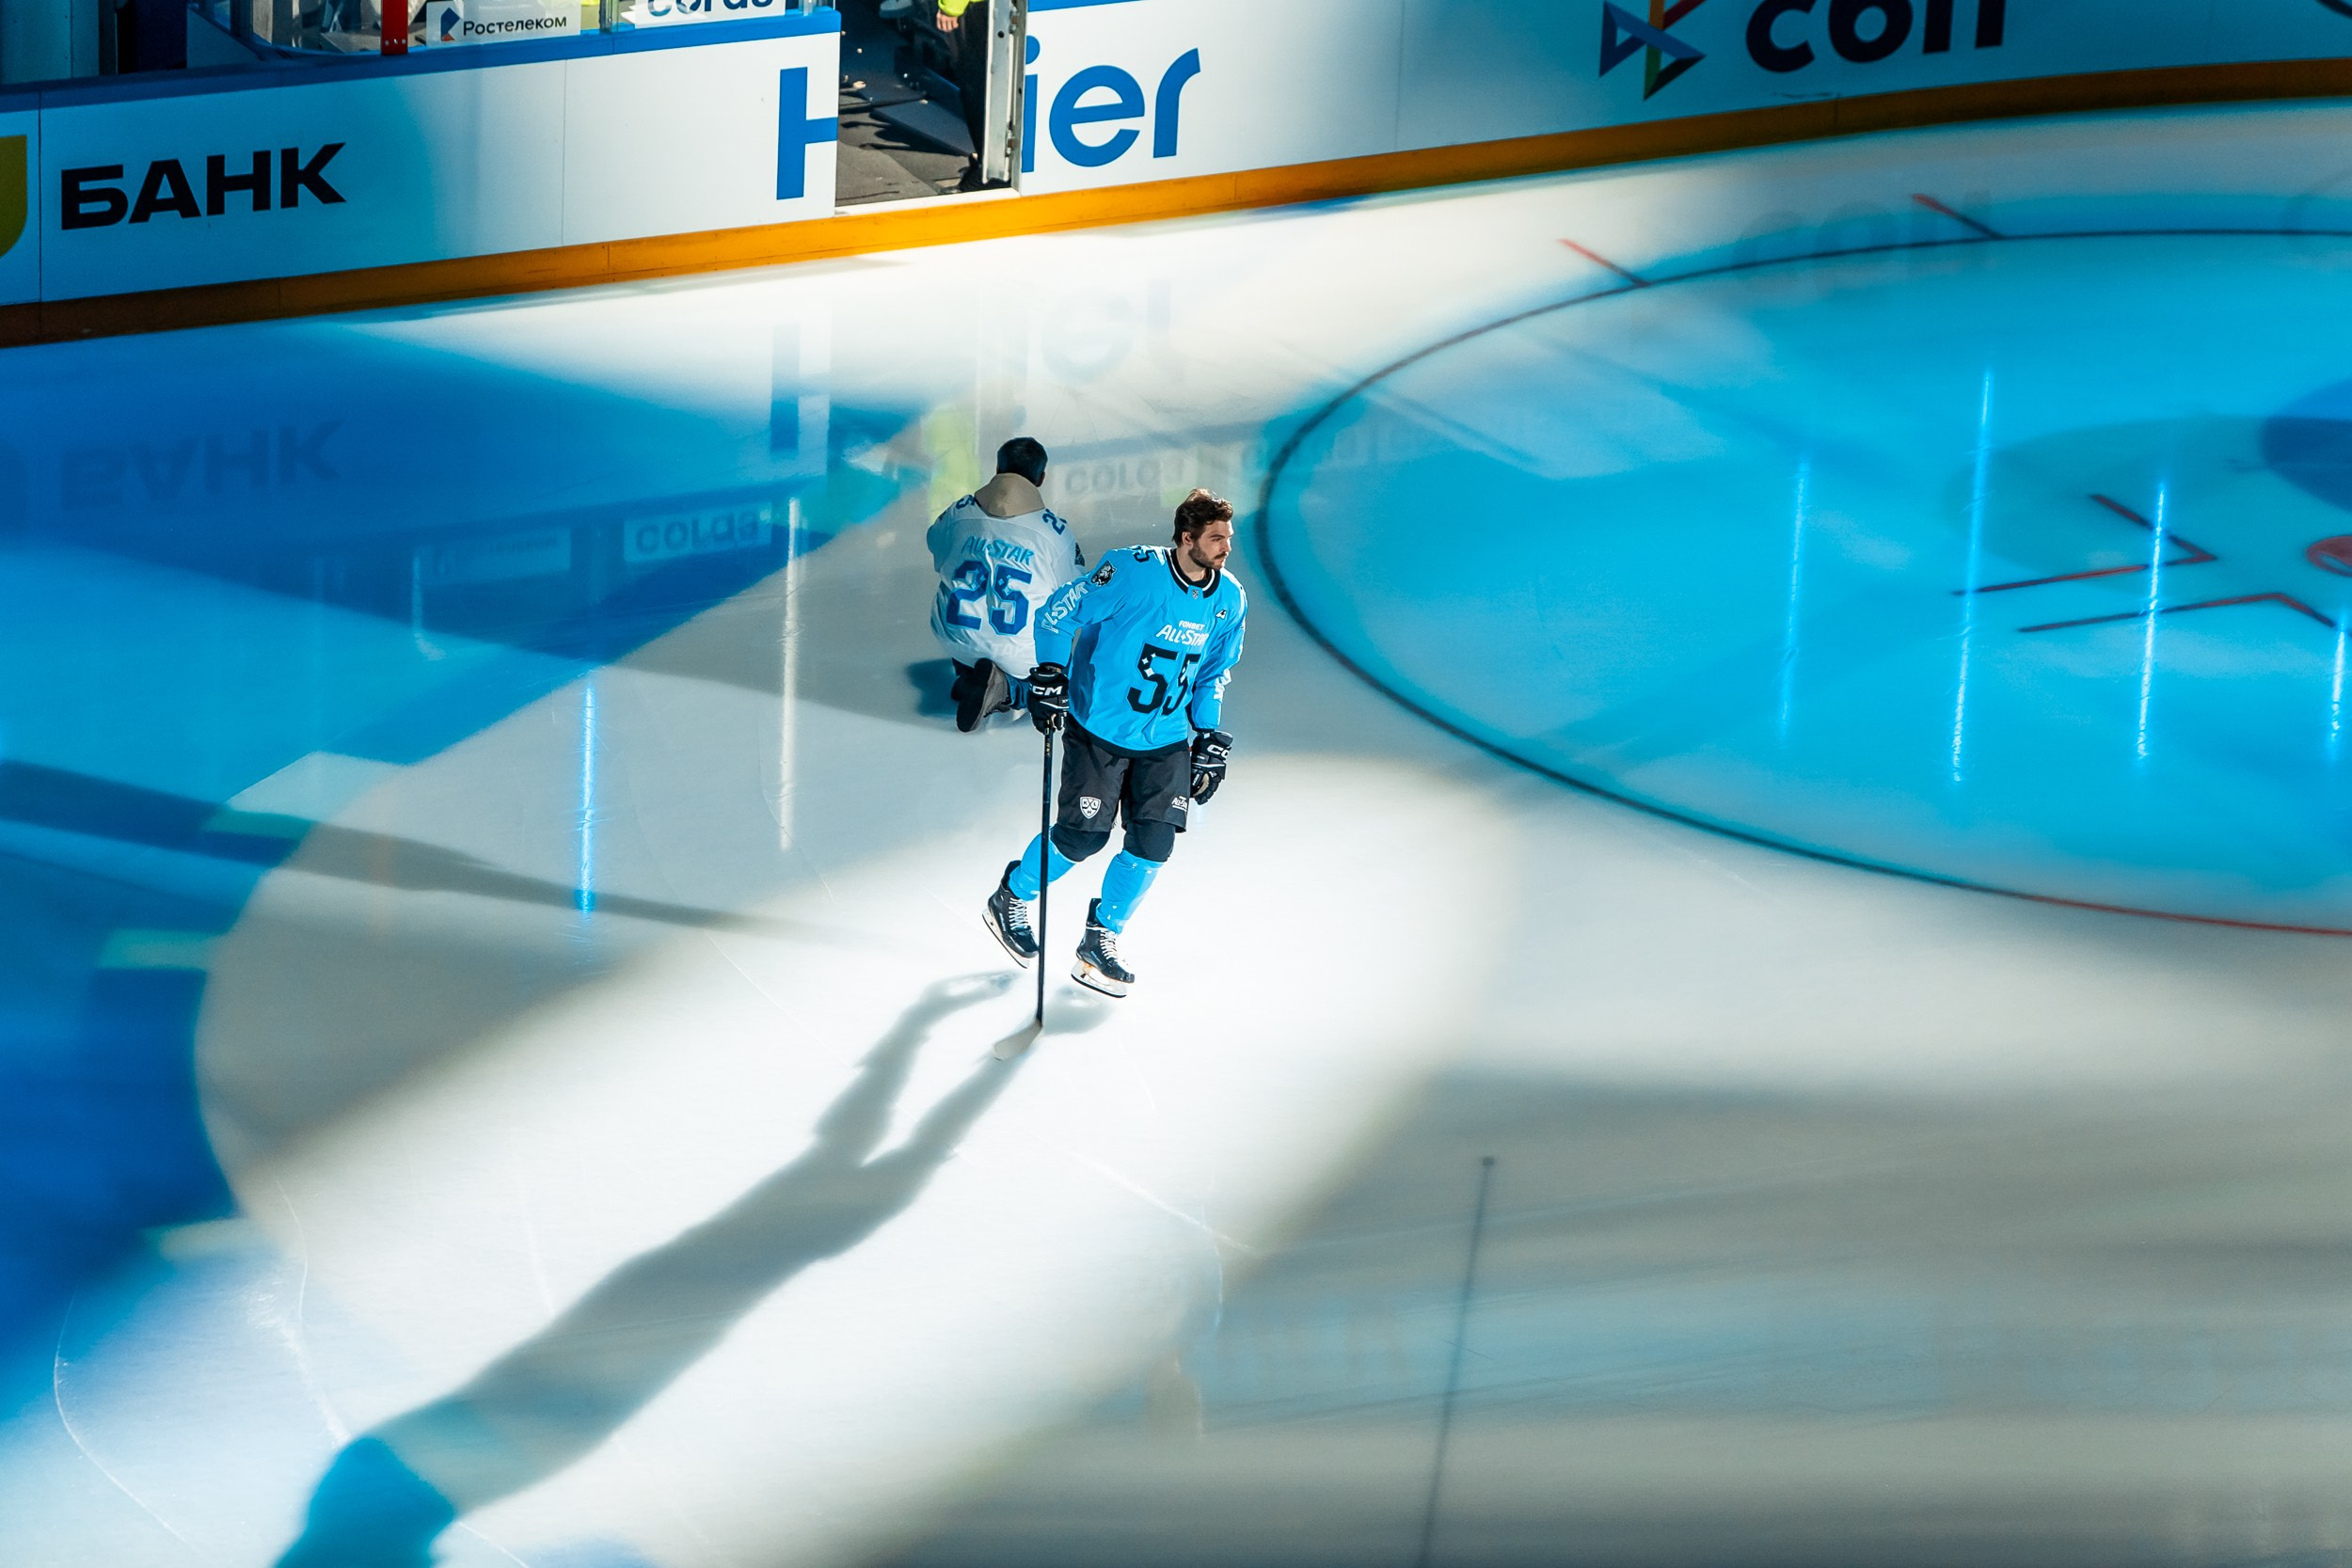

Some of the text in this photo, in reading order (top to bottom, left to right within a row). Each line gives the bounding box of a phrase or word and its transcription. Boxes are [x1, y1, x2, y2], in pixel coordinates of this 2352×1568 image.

[463, 16, 567, 36] Ростелеком
[60, 141, 347, 231] БАНК
[946, 560, 1033, 636] 25
[1178, 620, 1205, 632] FONBET
[1126, 642, 1201, 716] 55
